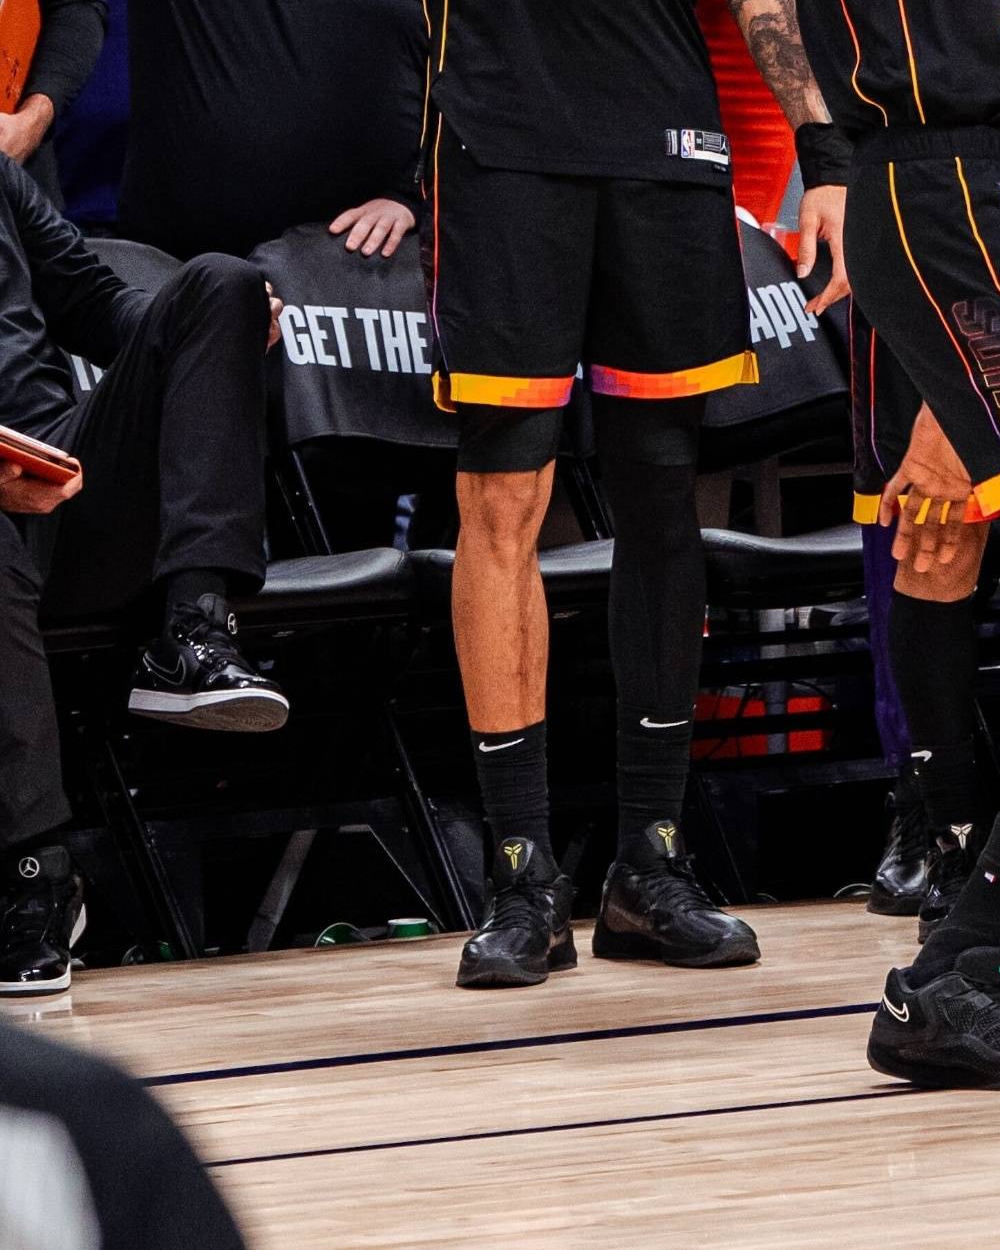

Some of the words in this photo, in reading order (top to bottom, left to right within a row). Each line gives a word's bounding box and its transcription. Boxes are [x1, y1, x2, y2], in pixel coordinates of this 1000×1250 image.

[278, 305, 352, 368] GET
[354, 308, 432, 374] THE
[748, 282, 819, 349] App
